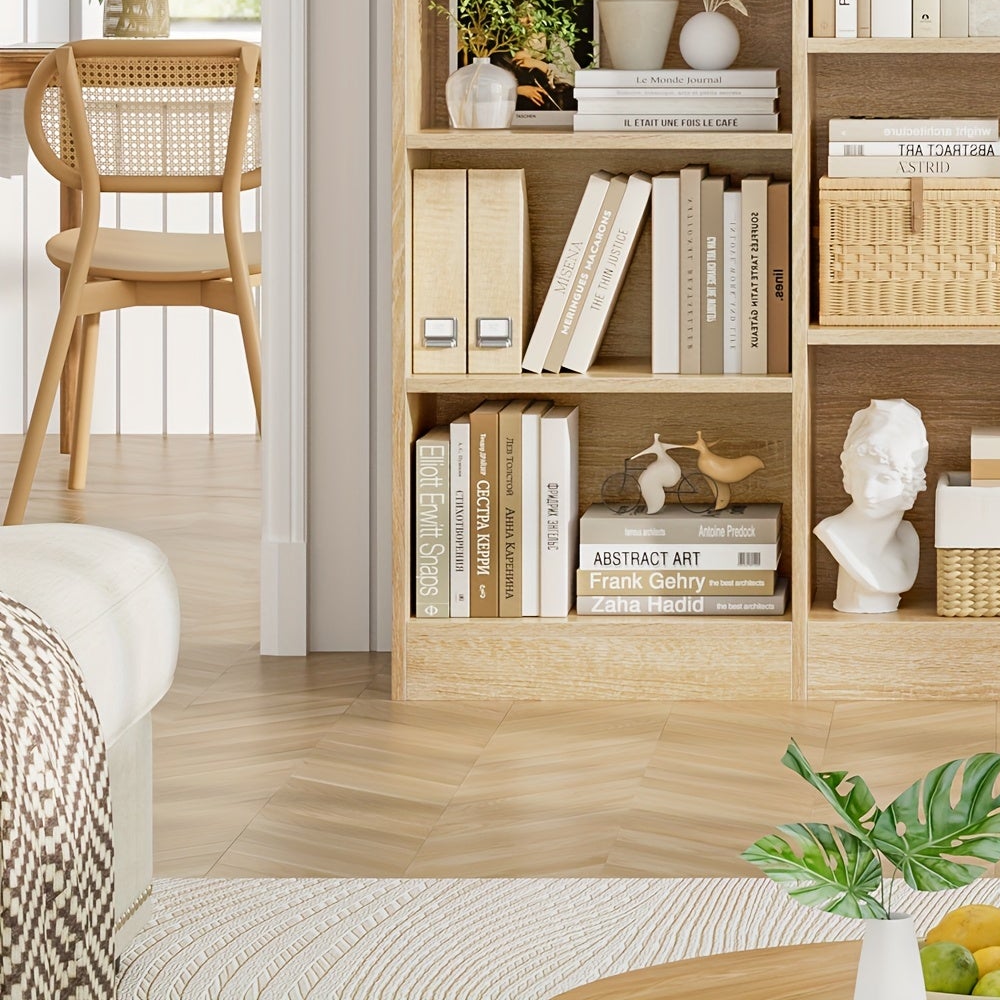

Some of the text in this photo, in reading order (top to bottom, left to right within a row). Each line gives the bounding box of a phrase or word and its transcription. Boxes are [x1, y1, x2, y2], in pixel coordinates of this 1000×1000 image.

[624, 119, 632, 127] IL
[662, 119, 678, 127] UNE
[681, 119, 700, 127] FOIS
[703, 119, 713, 127] LE
[715, 118, 738, 127] CAFÉ
[561, 210, 612, 334] MERINGUES MACARONS
[591, 229, 629, 311] THE THIN JUSTICE
[417, 446, 445, 596] Elliott Erwitt Snaps
[455, 490, 464, 572] СТИХОТВОРЕНИЯ
[476, 480, 490, 575] СЕСТРА КЕРРИ
[547, 483, 559, 551] ФРИДРИХ ЭНГЕЛЬС
[699, 525, 756, 538] Antoine Predock
[590, 572, 643, 589] Frank
[649, 573, 705, 593] Gehry
[594, 552, 700, 566] ABSTRACT ART
[591, 597, 641, 612] Zaha
[647, 596, 704, 612] Hadid
